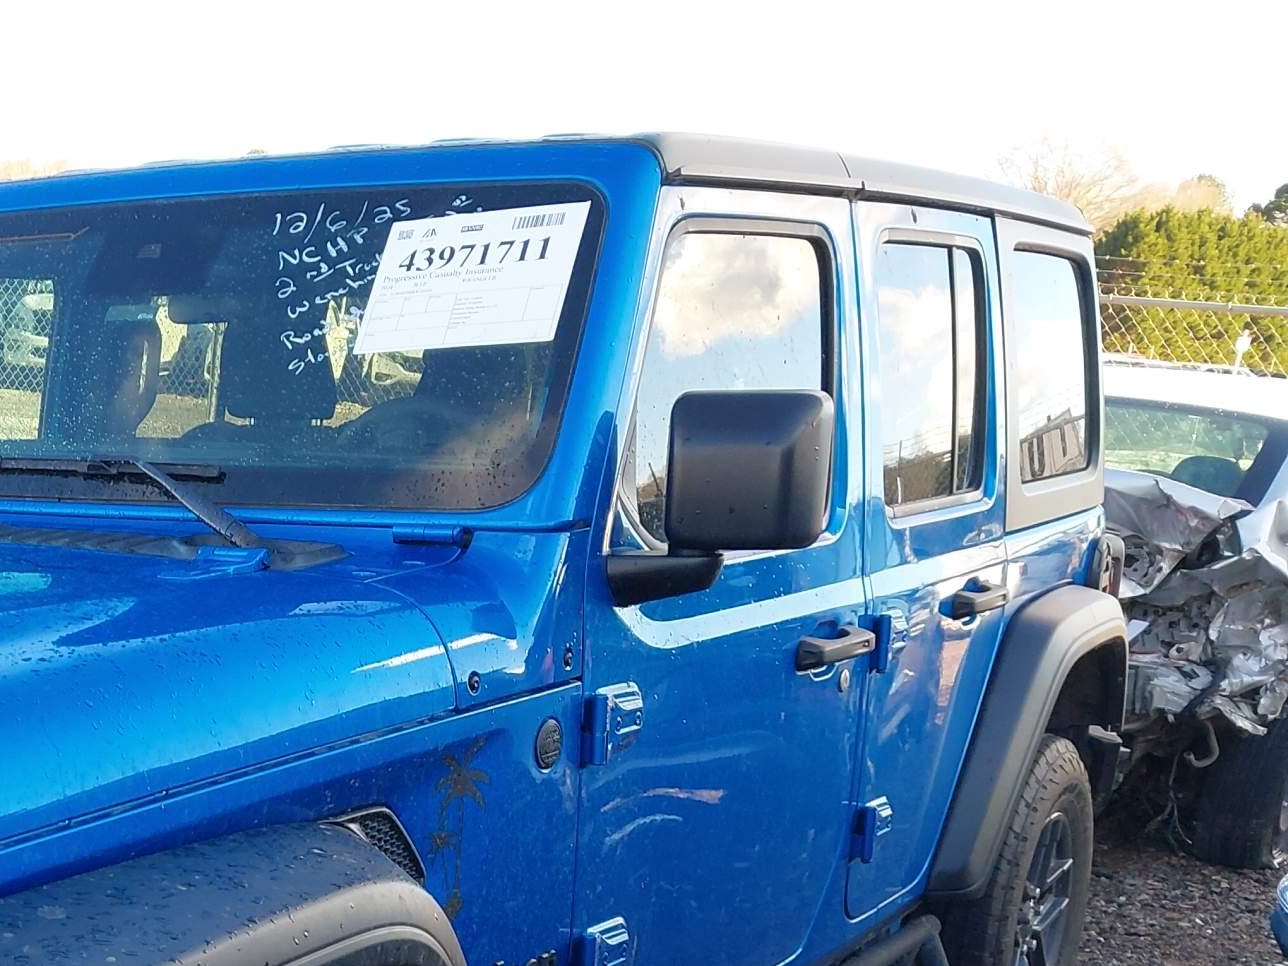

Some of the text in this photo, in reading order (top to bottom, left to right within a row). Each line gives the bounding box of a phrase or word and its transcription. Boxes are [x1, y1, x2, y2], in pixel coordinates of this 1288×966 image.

[273, 199, 411, 243] 12/6/25
[398, 236, 551, 272] 43971711
[383, 271, 428, 283] Progressive
[429, 269, 462, 280] Casualty
[465, 265, 504, 276] Insurance
